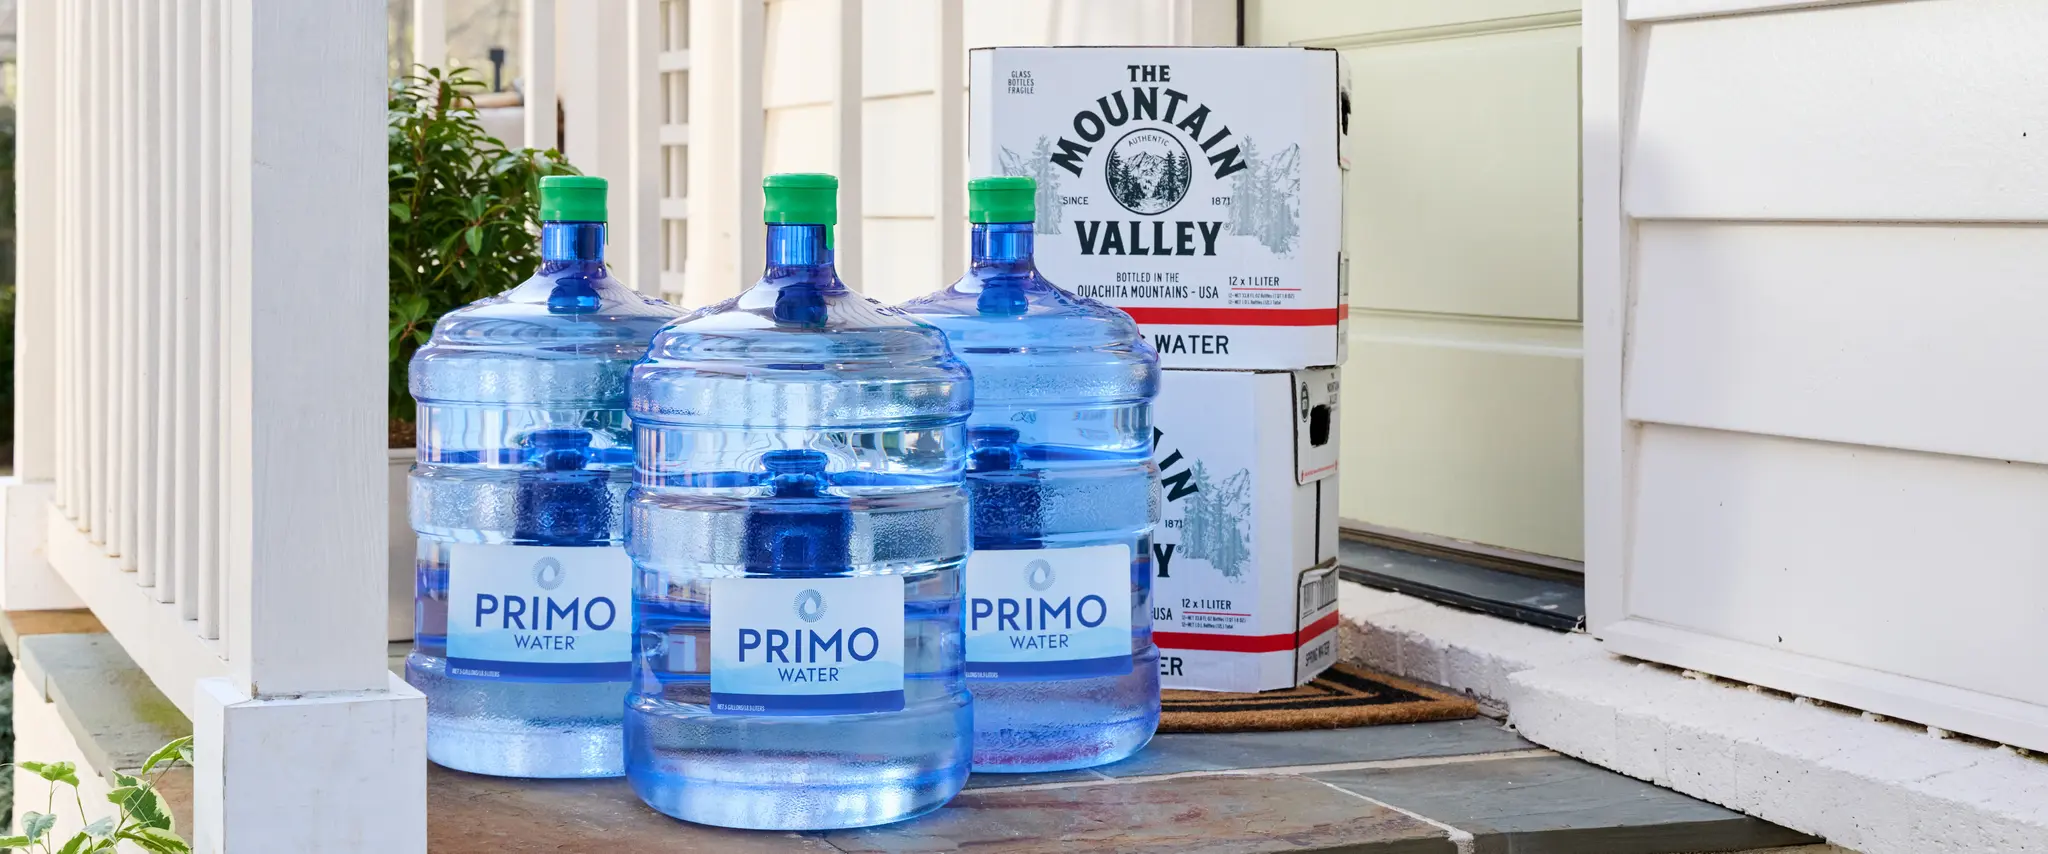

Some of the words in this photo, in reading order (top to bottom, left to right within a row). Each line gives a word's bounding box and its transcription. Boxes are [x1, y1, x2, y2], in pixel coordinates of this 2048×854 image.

[1011, 70, 1031, 78] GLASS
[1127, 64, 1170, 82] THE
[1008, 78, 1035, 86] BOTTLES
[1008, 86, 1034, 94] FRAGILE
[1050, 86, 1248, 180] MOUNTAIN
[1128, 134, 1169, 147] AUTHENTIC
[1062, 196, 1089, 205] SINCE
[1211, 196, 1231, 205] 1871
[1074, 220, 1223, 256] VALLEY
[1116, 272, 1150, 283] BOTTLED
[1154, 272, 1162, 283] IN
[1165, 272, 1179, 283] THE
[1228, 276, 1238, 286] 12
[1248, 276, 1252, 286] 1
[1254, 276, 1280, 287] LITER
[1077, 284, 1128, 298] OUACHITA
[1130, 285, 1188, 299] MOUNTAINS
[1199, 286, 1219, 299] USA
[1155, 334, 1229, 355] WATER
[1182, 598, 1191, 609] 12
[1201, 599, 1205, 609] 1
[1206, 599, 1232, 611] LITER
[475, 593, 617, 632] PRIMO
[971, 594, 1107, 631] PRIMO
[1153, 607, 1173, 621] USA
[514, 634, 575, 650] WATER
[738, 626, 879, 664] PRIMO
[1009, 633, 1069, 650] WATER
[777, 667, 839, 682] WATER
